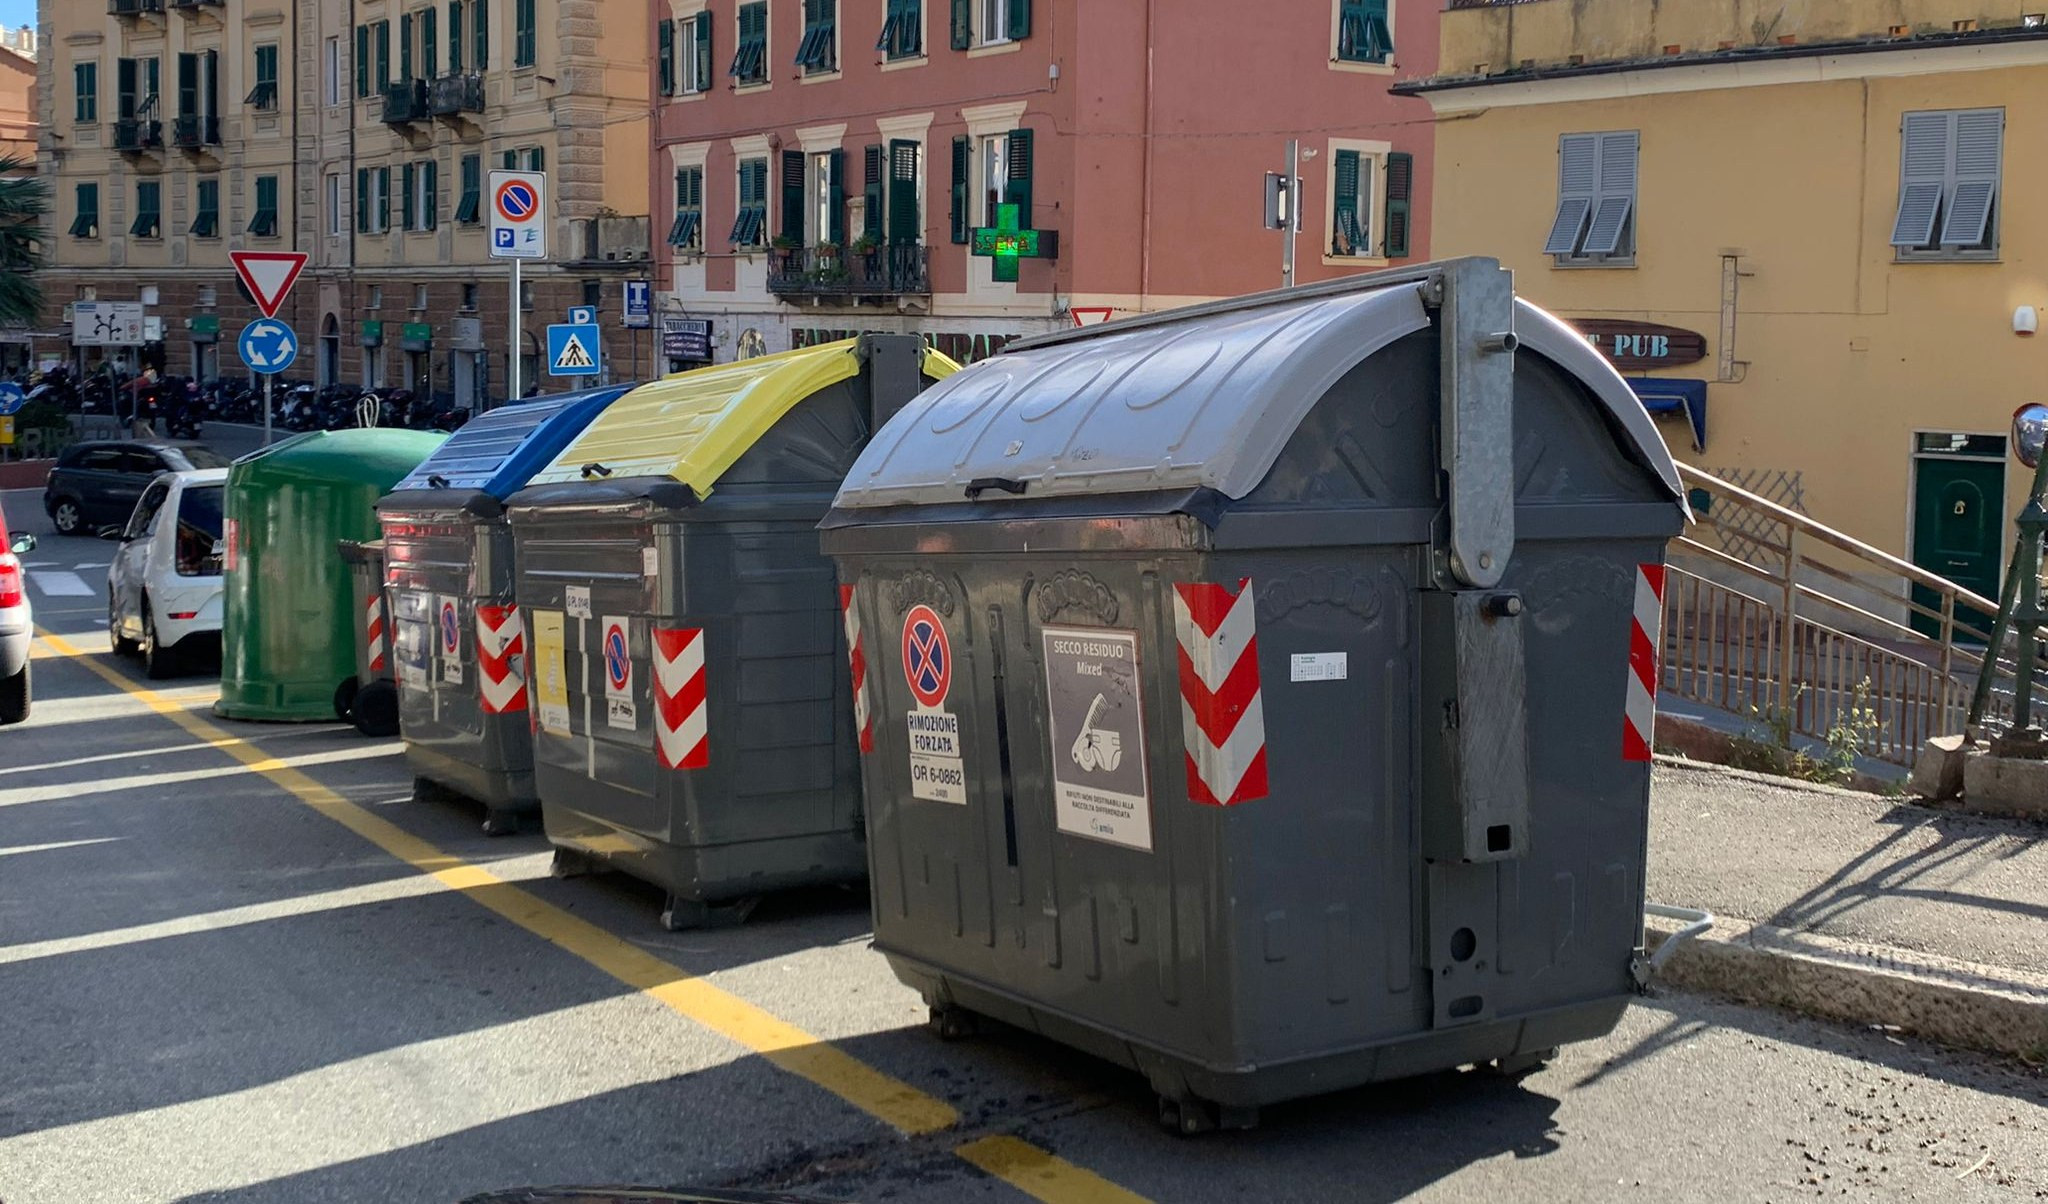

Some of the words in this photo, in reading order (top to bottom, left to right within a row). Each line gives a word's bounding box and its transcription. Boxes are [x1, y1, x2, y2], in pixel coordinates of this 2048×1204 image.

[499, 230, 511, 246] P
[574, 309, 590, 324] P
[1614, 334, 1669, 357] PUB
[1054, 640, 1081, 655] SECCO
[1083, 643, 1123, 658] RESIDUO
[1077, 661, 1102, 676] Mixed
[908, 715, 956, 733] RIMOZIONE
[915, 735, 953, 753] FORZATA
[913, 764, 928, 781] OR
[930, 767, 961, 786] 6-0862
[1072, 800, 1095, 812] RACCOLTA
[1095, 805, 1131, 819] DIFFERENZIATA
[1082, 793, 1093, 801] NON
[1122, 801, 1135, 810] ALLA
